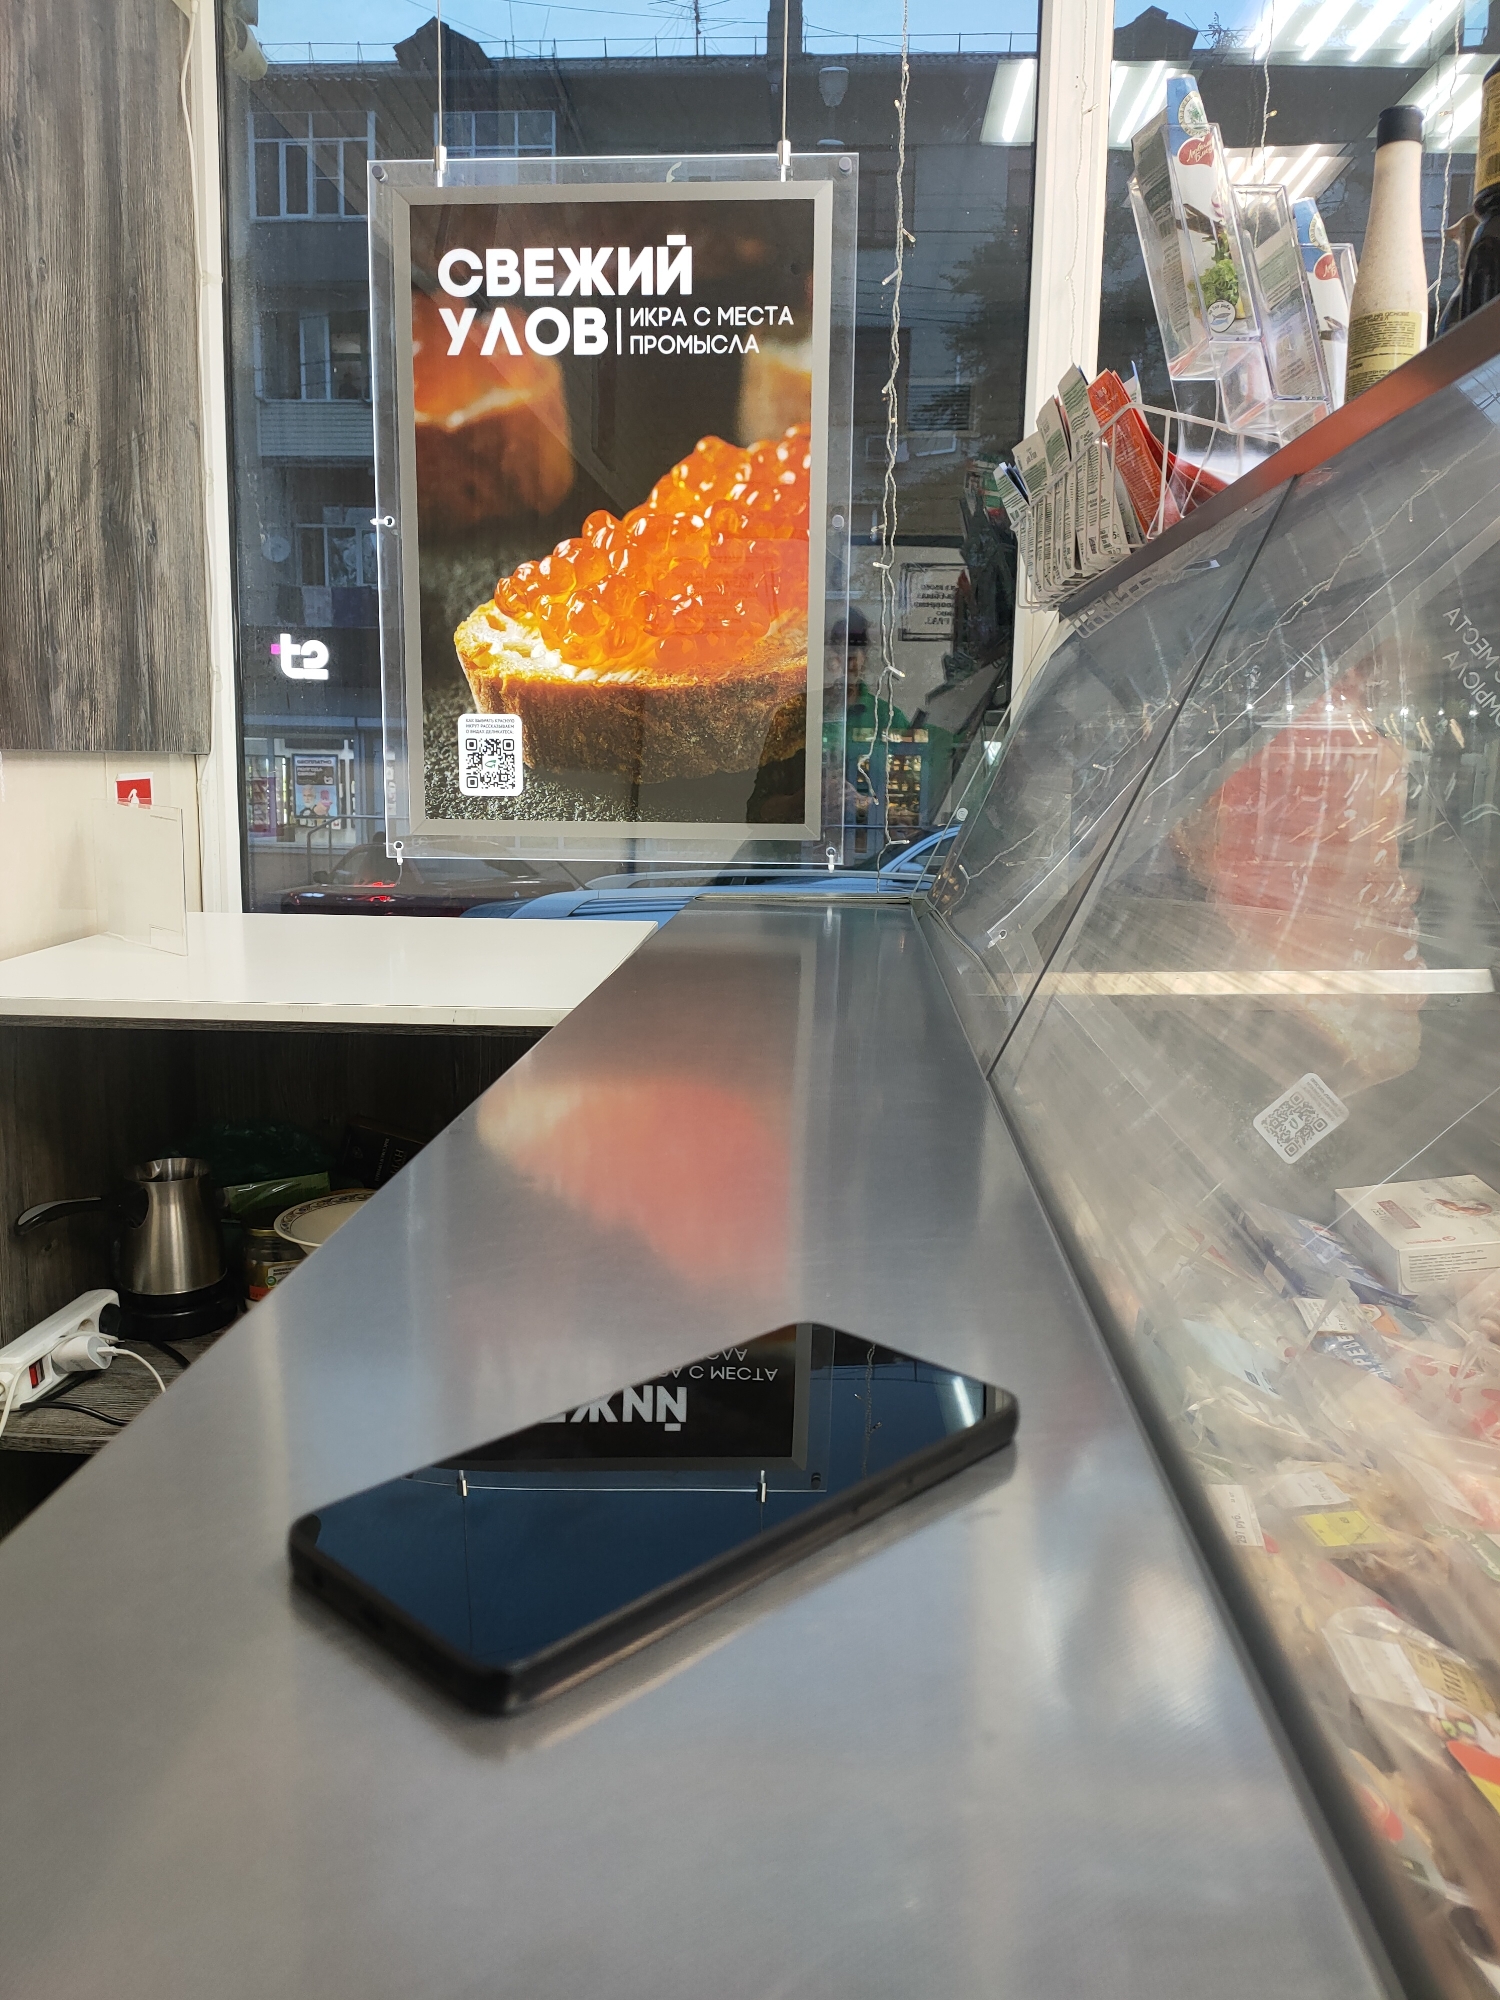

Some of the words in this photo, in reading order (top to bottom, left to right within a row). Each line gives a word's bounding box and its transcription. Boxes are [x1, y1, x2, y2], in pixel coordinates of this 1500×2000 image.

[437, 234, 693, 297] СВЕЖИЙ
[438, 306, 609, 356] УЛОВ
[629, 306, 688, 327] ИКРА
[693, 306, 711, 326] С
[718, 305, 794, 326] МЕСТА
[630, 334, 760, 355] ПРОМЫСЛА
[271, 633, 329, 680] t2
